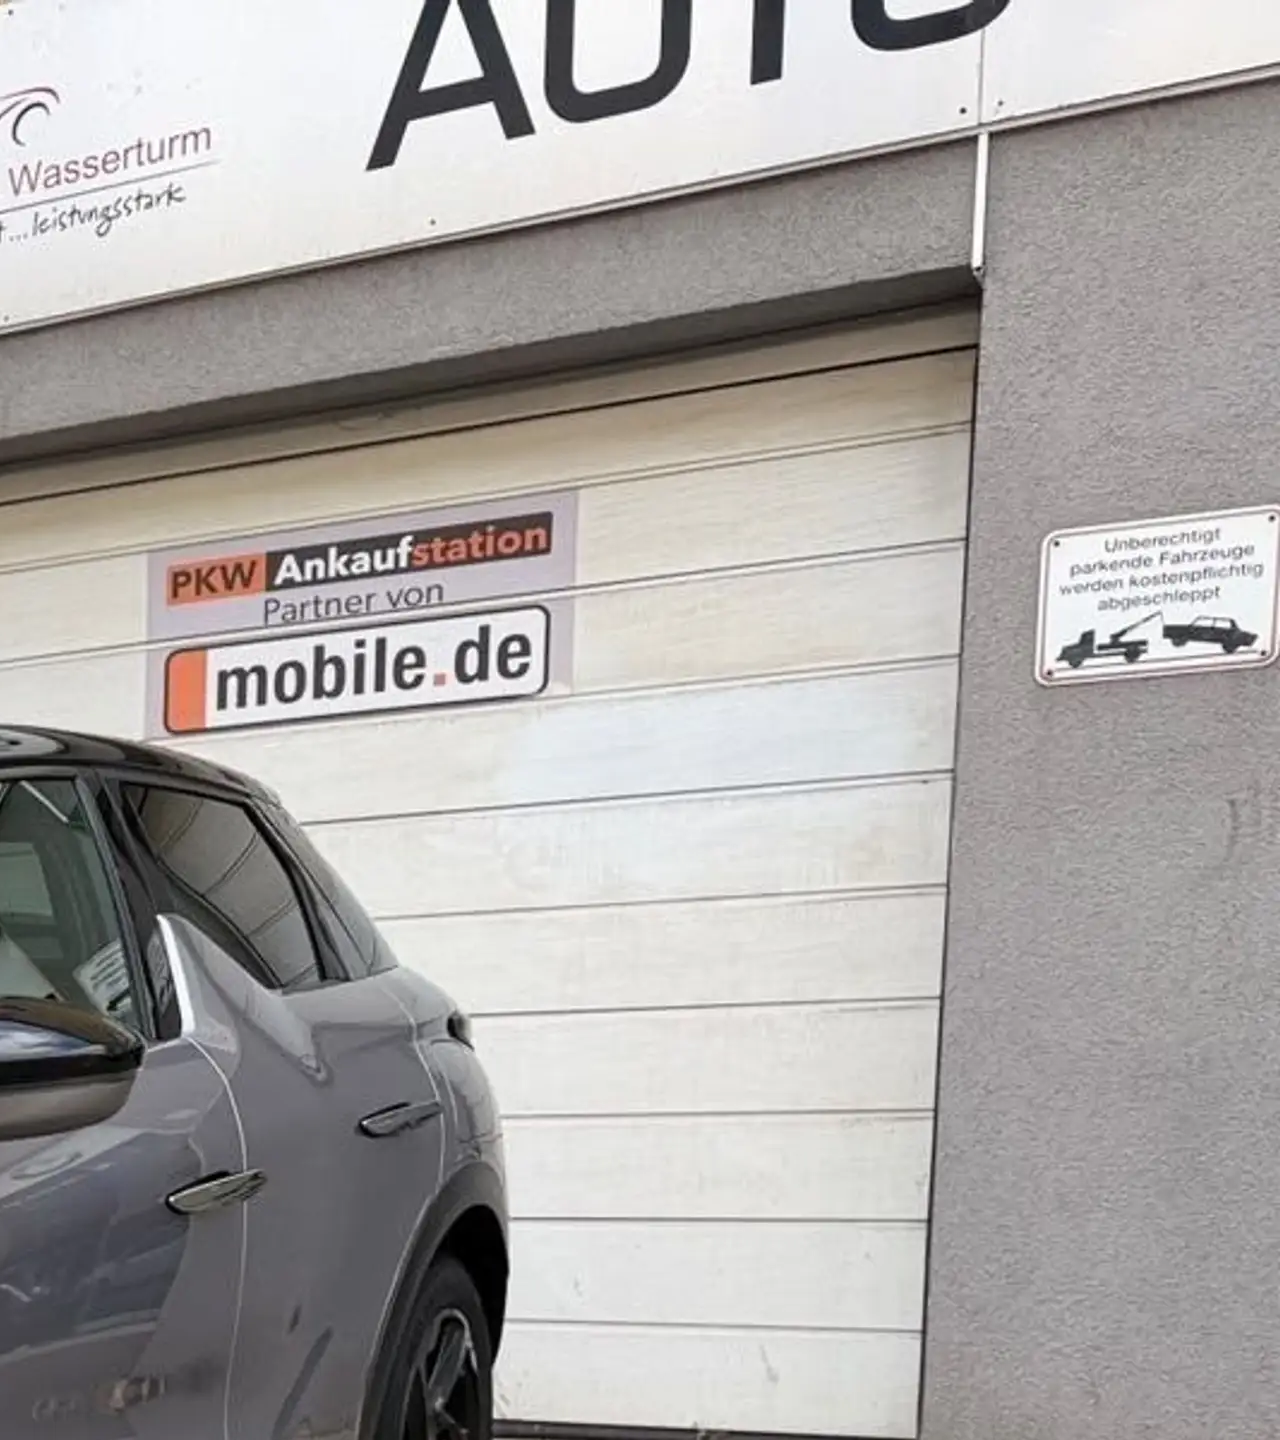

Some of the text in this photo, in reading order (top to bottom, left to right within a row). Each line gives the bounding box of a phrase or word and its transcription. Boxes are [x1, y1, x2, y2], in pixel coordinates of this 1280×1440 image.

[366, 0, 1009, 171] AU
[9, 127, 211, 196] Wasserturm
[172, 524, 547, 598] PKW Ankaufstation
[1070, 544, 1255, 578] parkende Fahrzeuge
[1104, 528, 1221, 553] Unberechtigt
[1060, 562, 1264, 596] werden kostenpflichtig
[1097, 585, 1221, 611] abgeschleppt
[264, 584, 444, 626] Partner von
[216, 624, 532, 711] mobile.de
